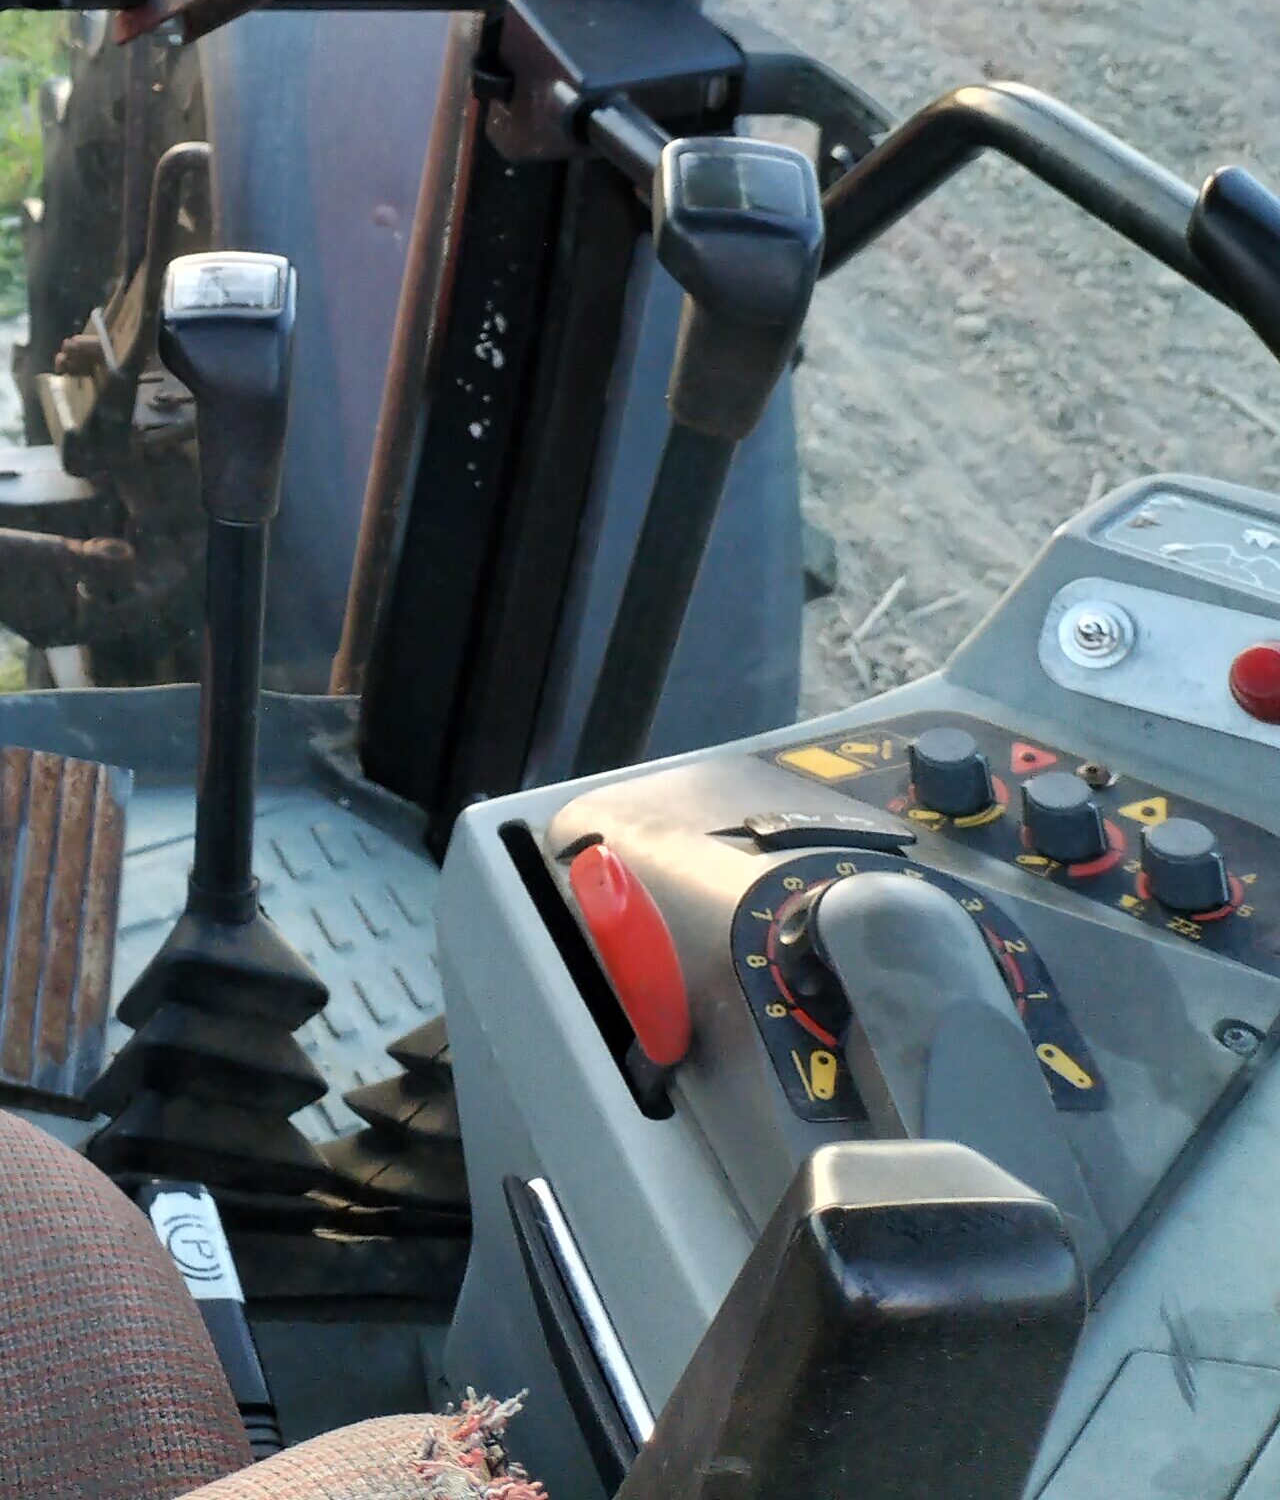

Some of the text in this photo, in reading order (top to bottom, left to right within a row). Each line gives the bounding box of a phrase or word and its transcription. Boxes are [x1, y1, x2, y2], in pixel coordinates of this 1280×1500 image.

[783, 877, 805, 892] 6
[960, 898, 985, 912] 3
[751, 908, 773, 922] 7
[1004, 939, 1029, 954] 2
[745, 954, 768, 969] 8
[1026, 990, 1049, 1001] 1
[765, 1003, 788, 1018] 9
